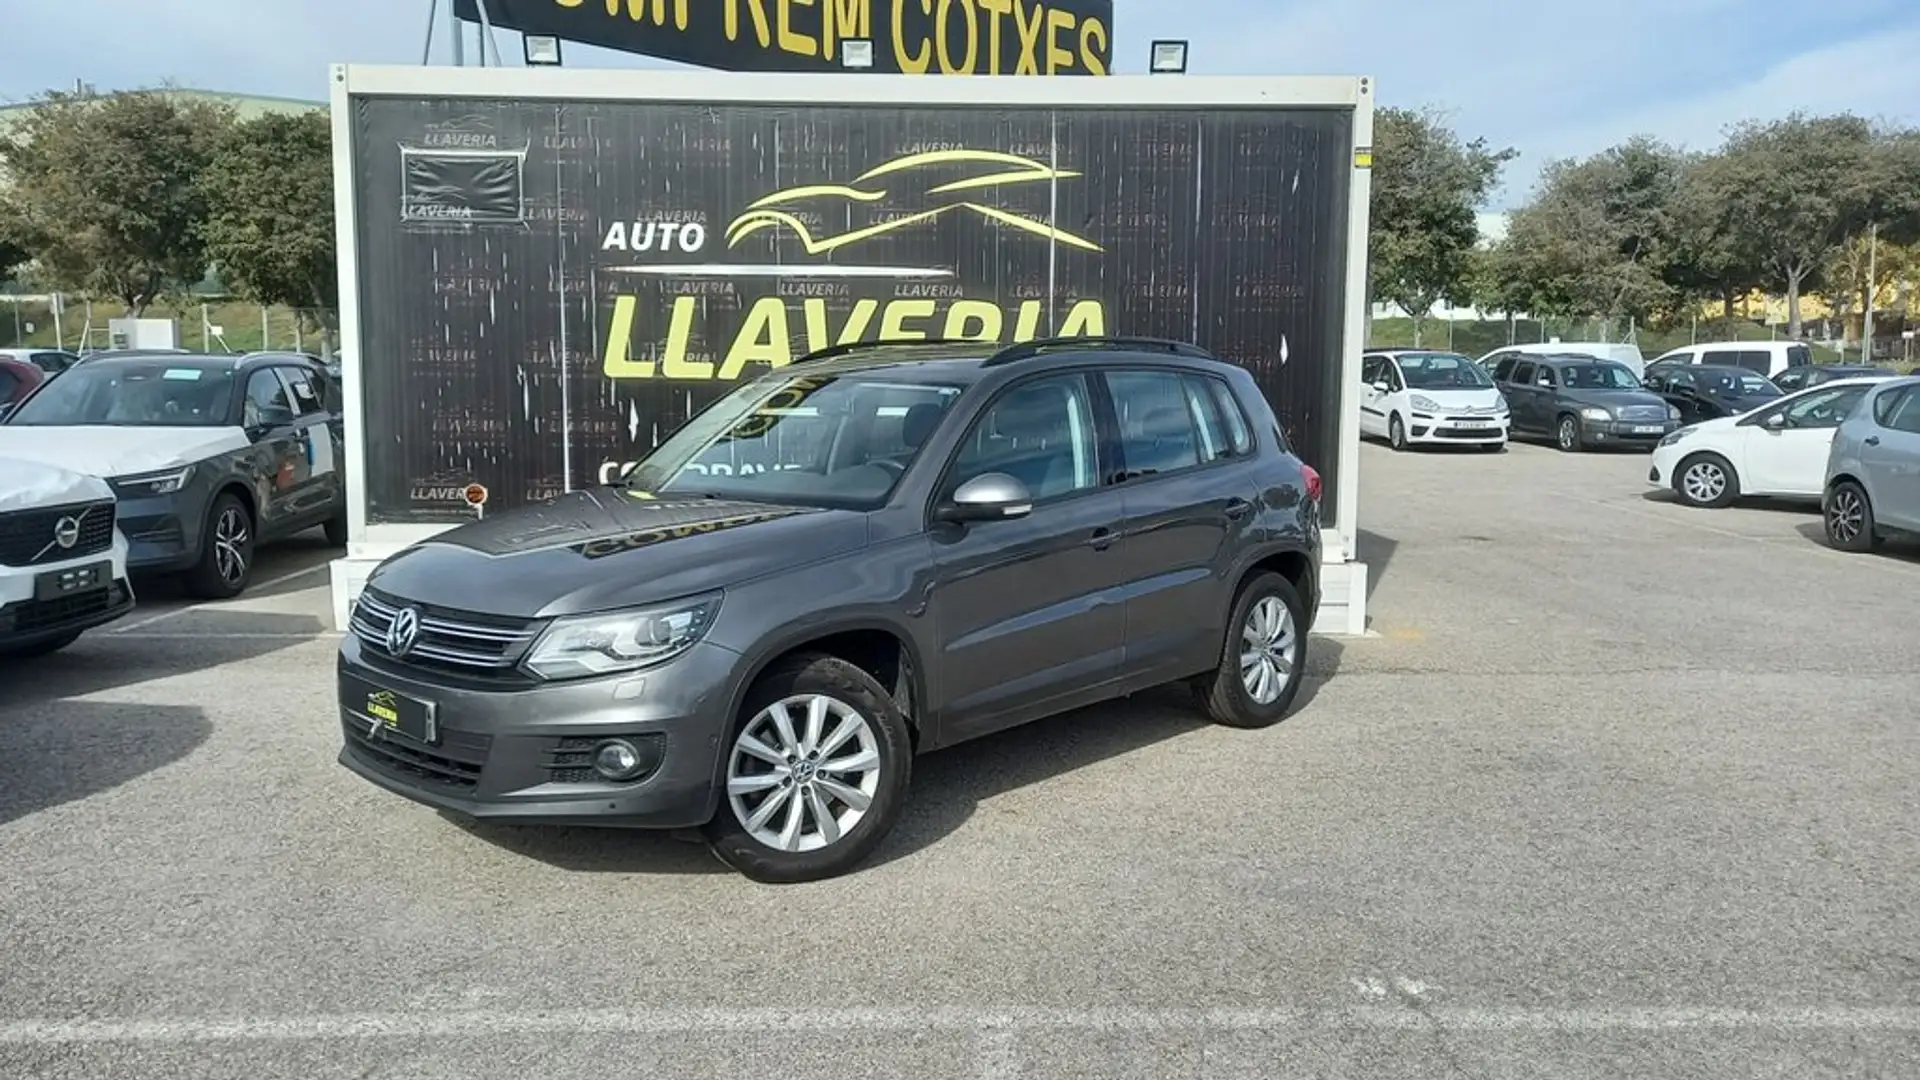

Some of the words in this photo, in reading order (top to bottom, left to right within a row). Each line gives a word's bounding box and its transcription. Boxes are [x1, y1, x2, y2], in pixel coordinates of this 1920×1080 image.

[890, 0, 1108, 75] COTXES
[423, 132, 497, 148] LLAVERIA
[601, 221, 705, 252] AUTO
[779, 282, 850, 296] LLAVERIA
[893, 283, 964, 298] LLAVERIA
[409, 487, 465, 500] LLAVER
